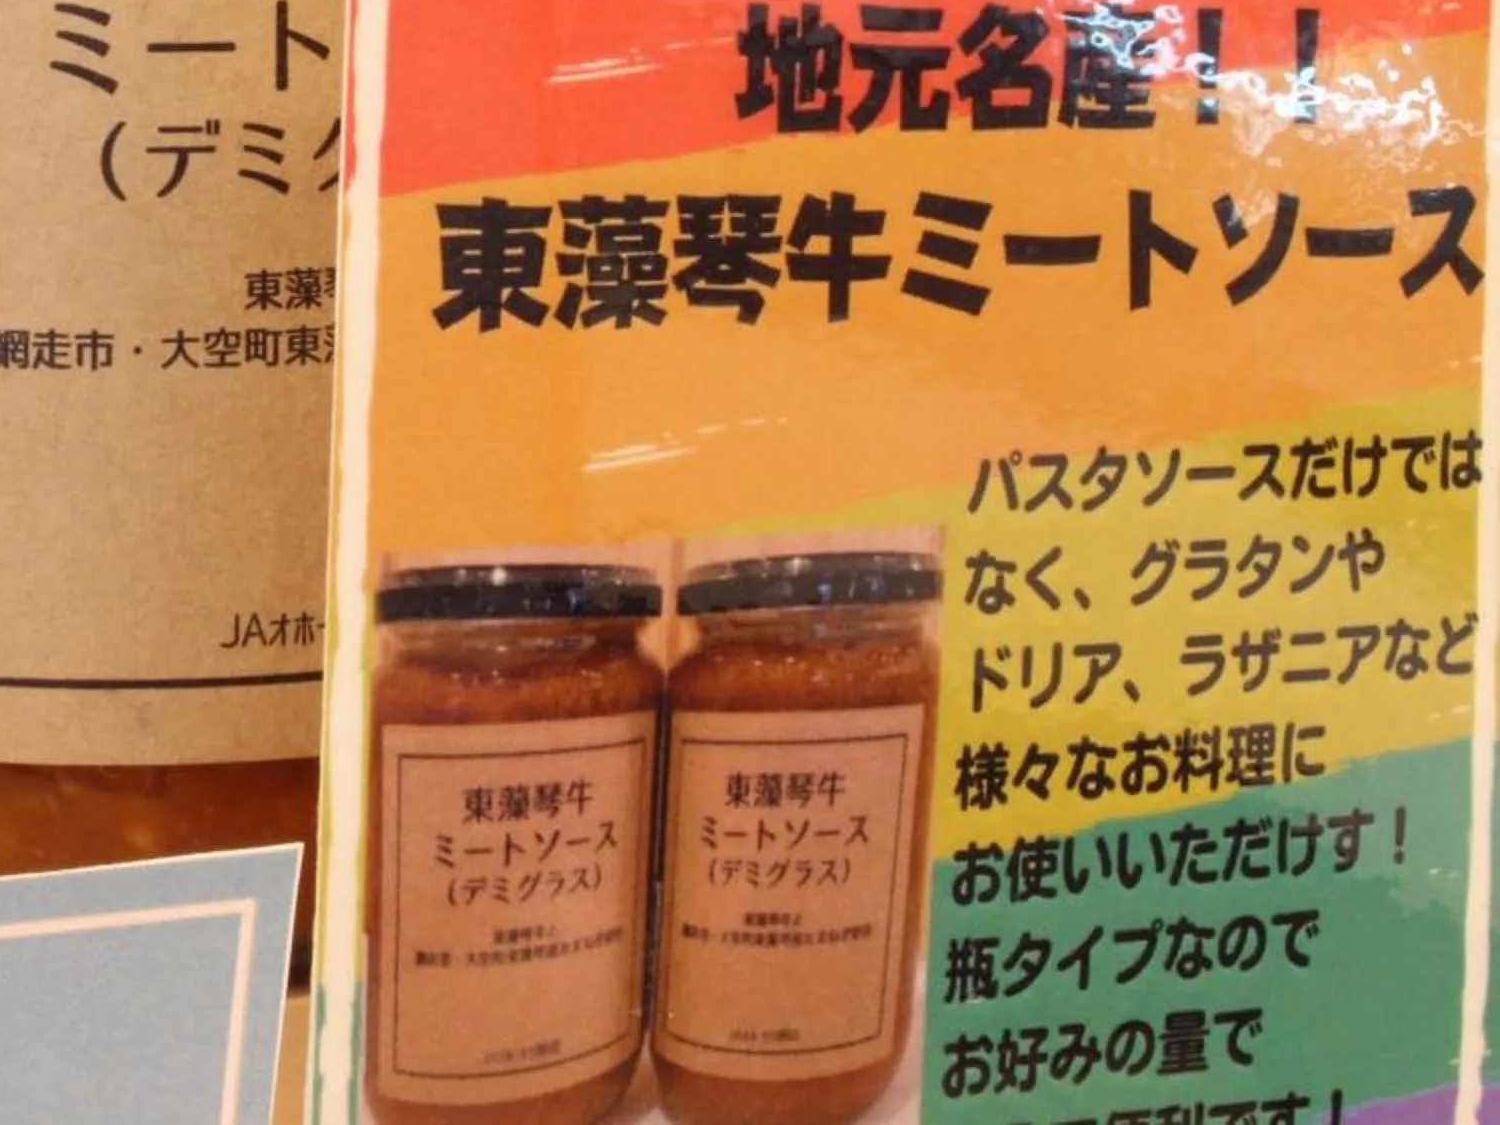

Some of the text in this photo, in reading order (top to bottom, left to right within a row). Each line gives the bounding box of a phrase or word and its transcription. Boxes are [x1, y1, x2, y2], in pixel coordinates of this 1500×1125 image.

[431, 185, 1485, 334] 東藻琴牛ミートソース
[966, 428, 1483, 515] パスタソースだけでは
[964, 527, 1386, 615] なく、グラタンや
[971, 616, 1480, 713] ドリア、ラザニアなど
[954, 721, 1327, 811] 様々なお料理に
[435, 820, 618, 869] ミートソース
[700, 815, 869, 852] ミートソース
[951, 806, 1407, 906] お使いいただけす！
[944, 909, 1321, 1004] 瓶タイプなので
[941, 1007, 1264, 1098] お好みの量で
